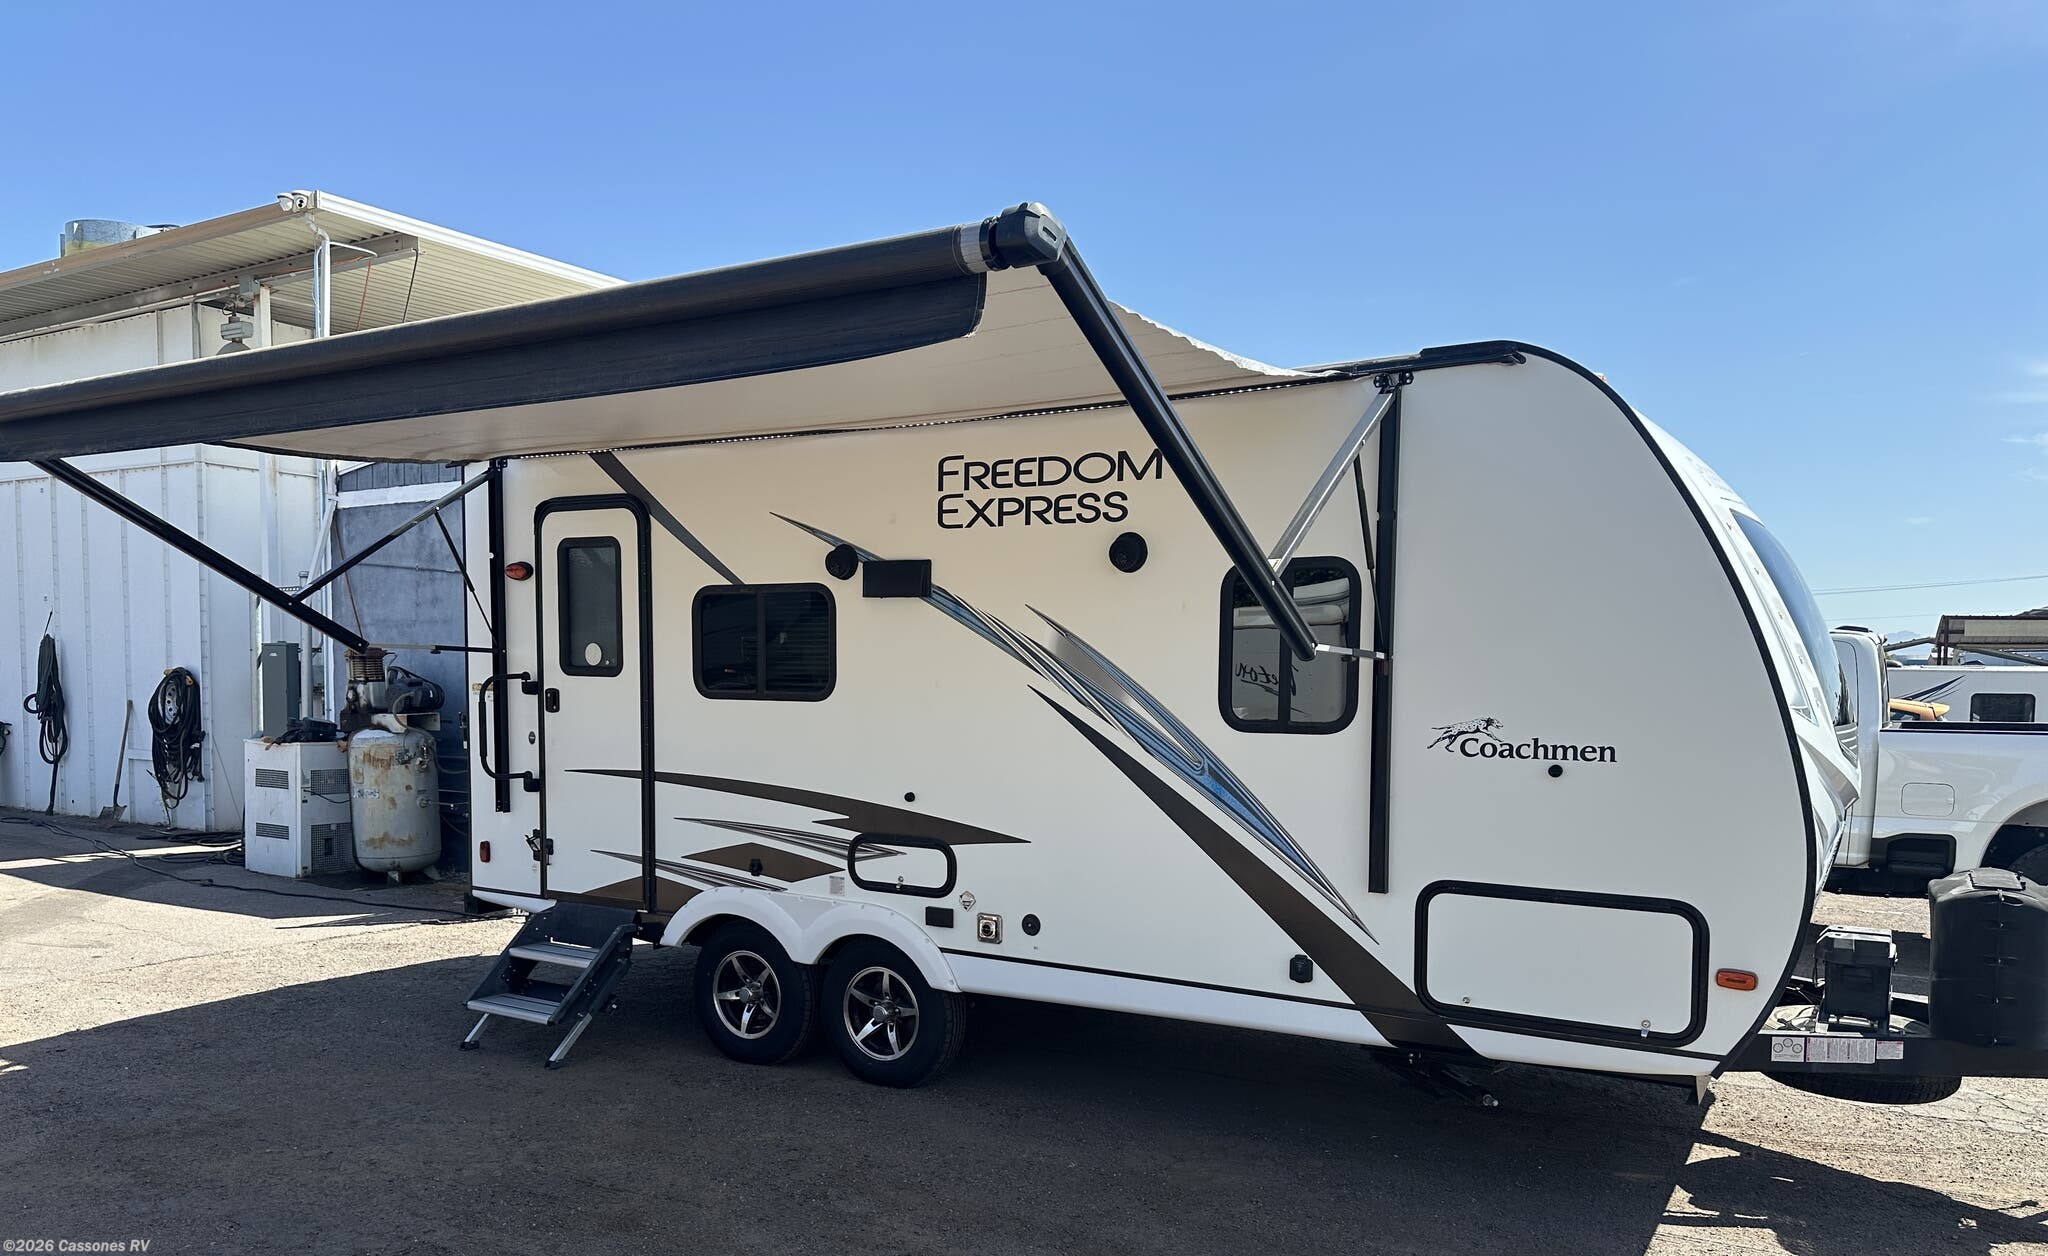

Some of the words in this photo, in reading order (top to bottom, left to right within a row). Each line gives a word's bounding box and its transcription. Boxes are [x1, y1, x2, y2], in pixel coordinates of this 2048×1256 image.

[938, 449, 1163, 492] FREEDOM
[937, 491, 1128, 529] EXPRESS
[1459, 737, 1617, 763] Coachmen
